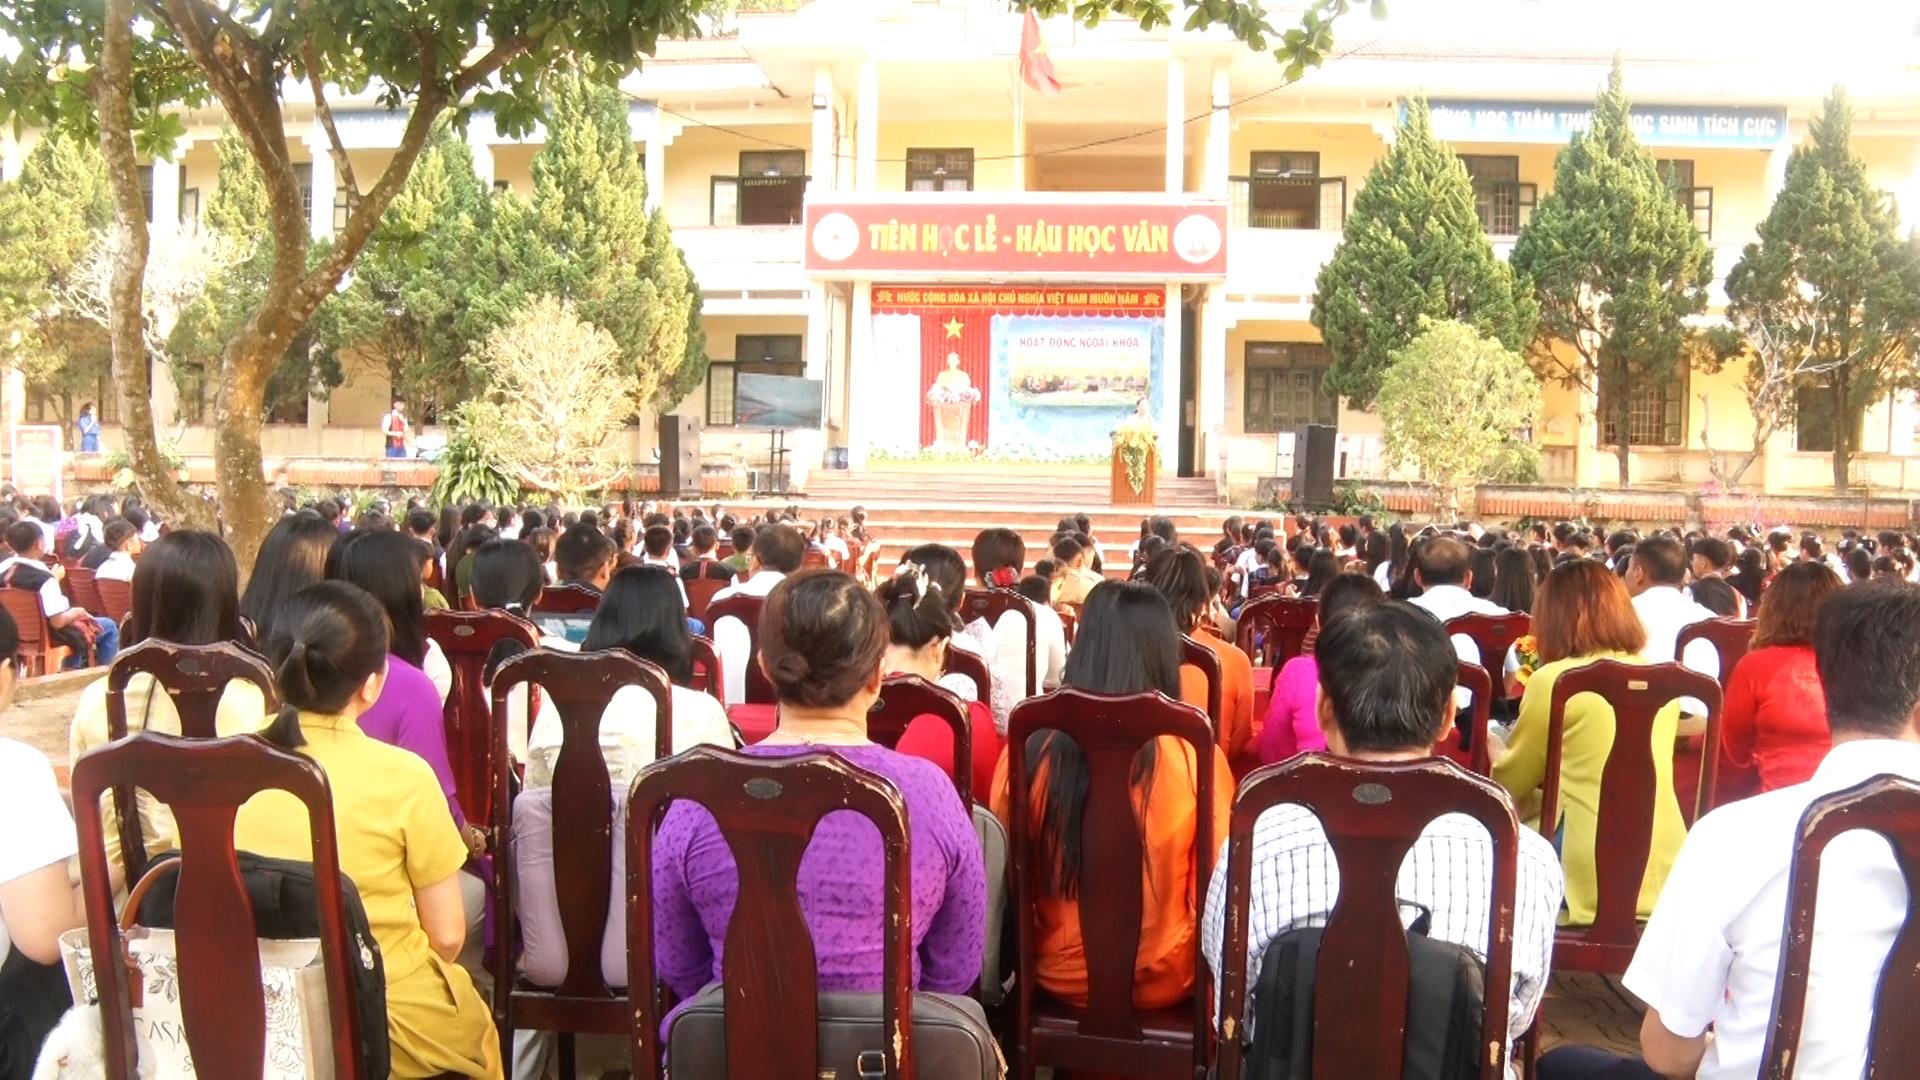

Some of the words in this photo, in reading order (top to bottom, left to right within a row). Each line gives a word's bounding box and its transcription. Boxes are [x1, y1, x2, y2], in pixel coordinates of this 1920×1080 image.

[1475, 110, 1508, 134] HỌC
[1512, 108, 1555, 129] THÂN
[1659, 114, 1698, 134] SINH
[1703, 113, 1739, 136] TÍCH
[1742, 116, 1777, 139] CỰC
[868, 218, 917, 252] TIÊN
[974, 213, 998, 252] LỄ
[1016, 219, 1063, 258] HẬU
[1068, 224, 1116, 258] HỌC
[1122, 219, 1169, 253] VĂN
[897, 290, 920, 303] NƯỚC
[922, 290, 947, 305] CỘNG
[981, 290, 996, 306] HỘI
[998, 289, 1016, 304] CHỦ
[1018, 291, 1044, 304] NGHĨA
[1046, 291, 1065, 306] VIỆT
[1067, 293, 1087, 304] NAM
[1089, 291, 1116, 304] MUÔN
